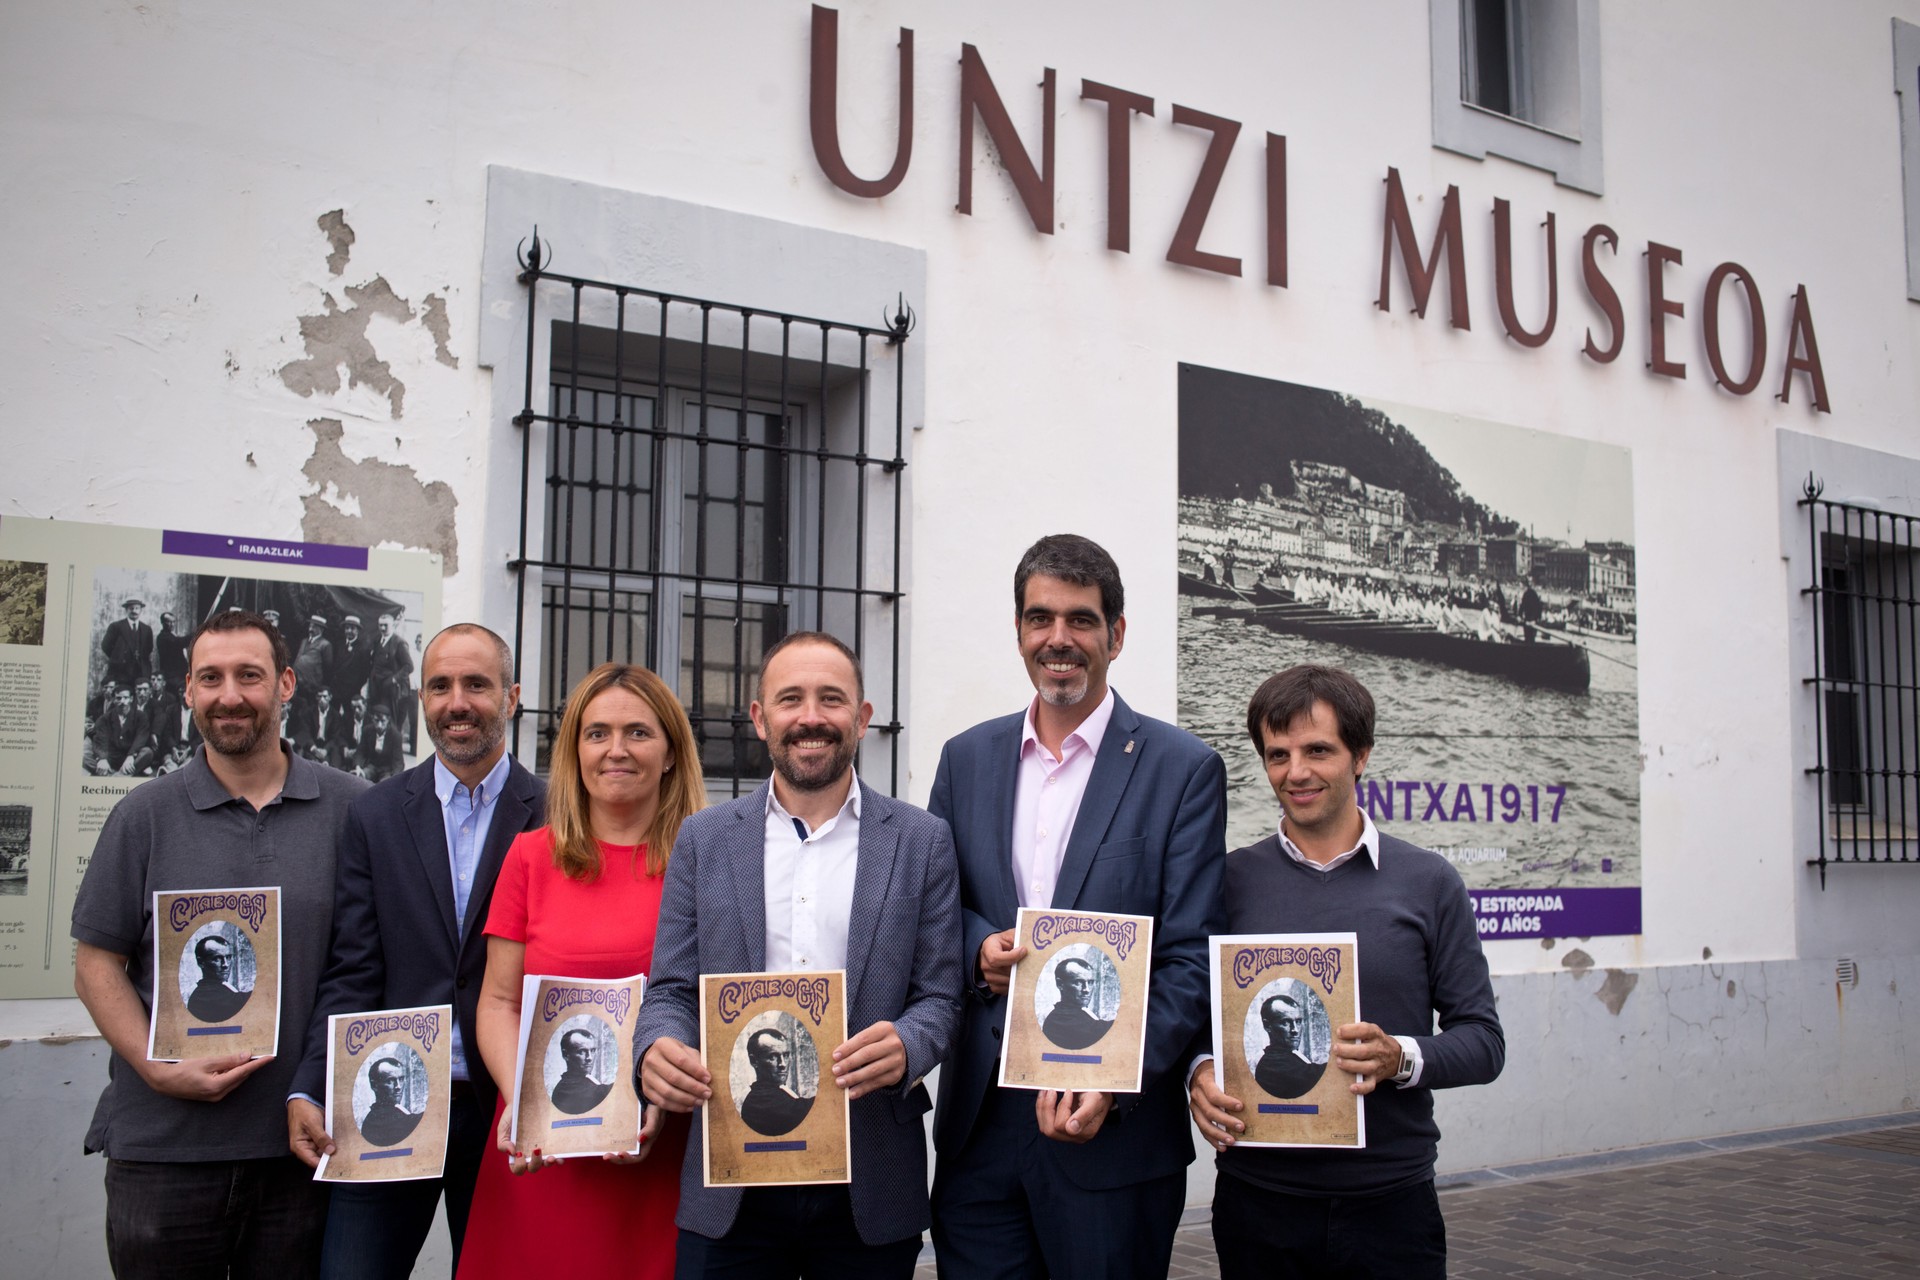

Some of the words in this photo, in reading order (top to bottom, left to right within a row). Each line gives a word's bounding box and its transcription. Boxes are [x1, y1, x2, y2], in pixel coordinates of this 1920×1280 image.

[809, 3, 1288, 289] UNTZI
[1377, 166, 1831, 414] MUSEOA
[239, 544, 304, 558] IRABAZLEAK
[1458, 847, 1507, 864] AQUARIUM
[170, 893, 267, 933] CIABOGA
[1480, 895, 1564, 913] ESTROPADA
[1500, 913, 1542, 933] AÑOS
[1032, 915, 1138, 961] CIABOGA
[1233, 946, 1341, 994] CIABOGA
[543, 987, 631, 1026] CIABOGA
[718, 977, 830, 1026] CIABOGA
[346, 1012, 440, 1056] CIABOGA
